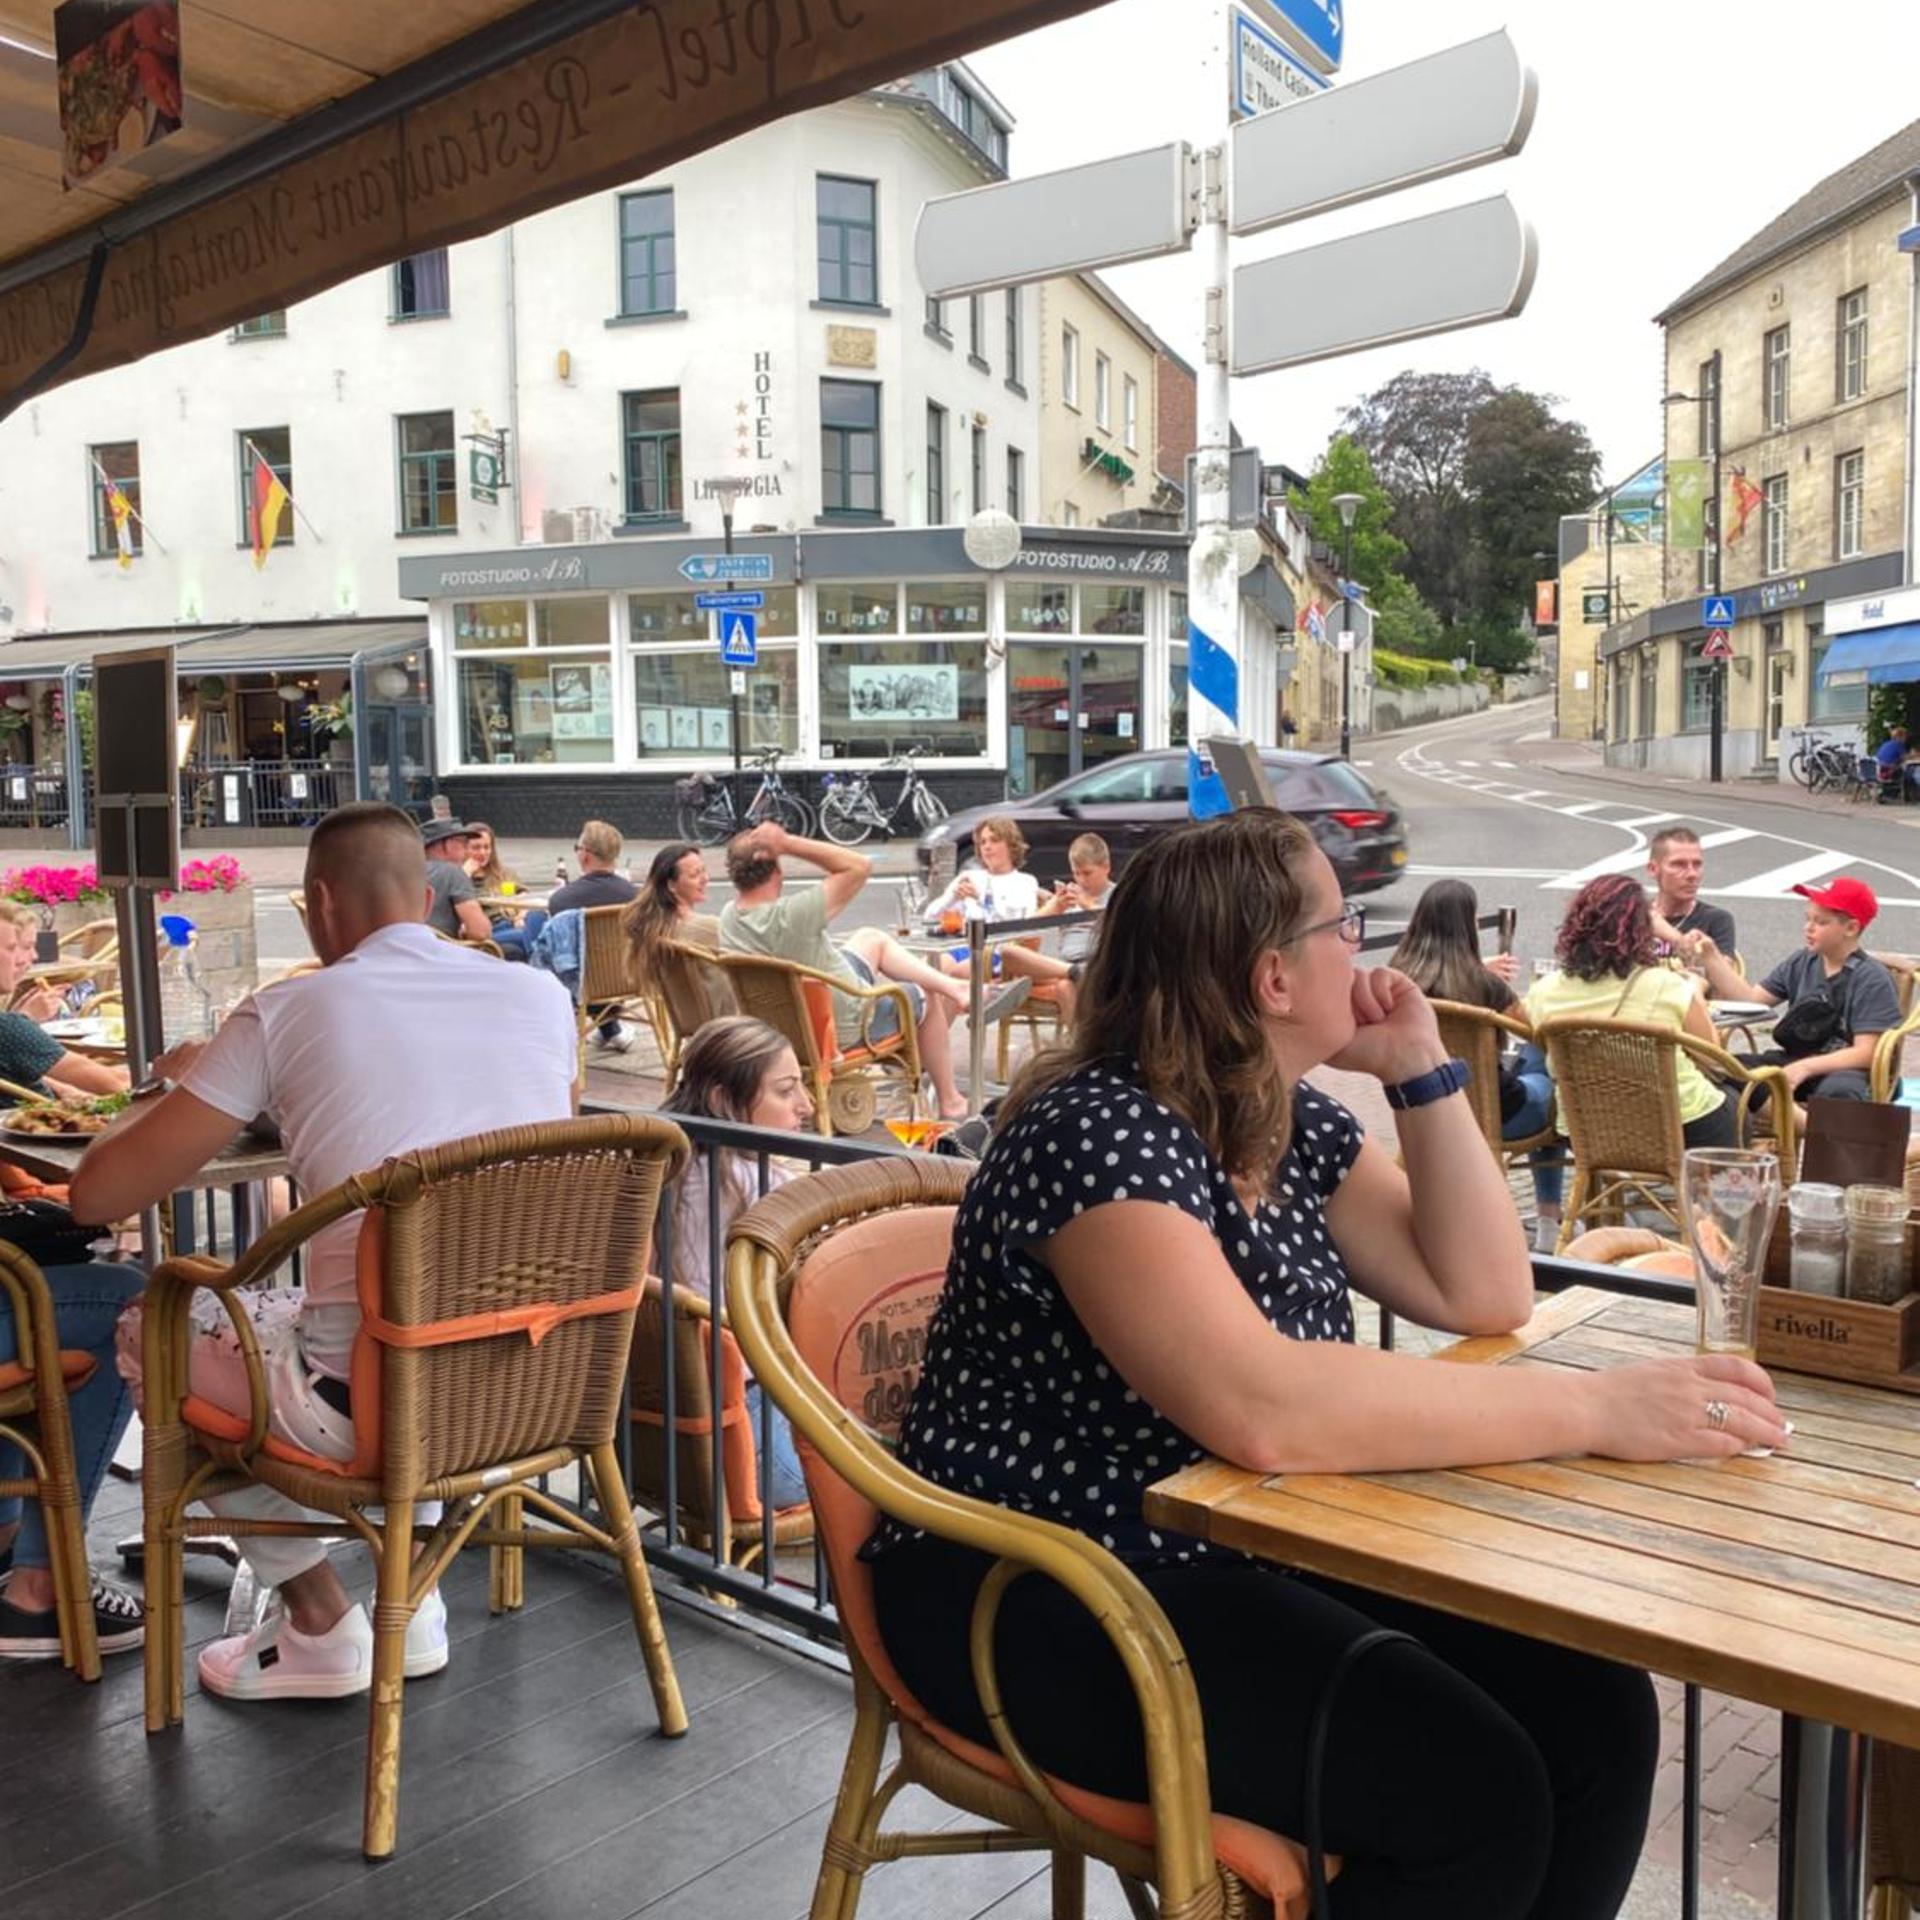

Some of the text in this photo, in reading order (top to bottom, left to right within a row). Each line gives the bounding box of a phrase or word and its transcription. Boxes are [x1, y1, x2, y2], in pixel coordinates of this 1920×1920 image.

[1242, 32, 1282, 82] Holland
[755, 351, 772, 460] HOTEL
[439, 567, 531, 587] FOTOSTUDIO
[1015, 551, 1116, 571] FOTOSTUDIO
[1774, 1313, 1850, 1345] rivella
